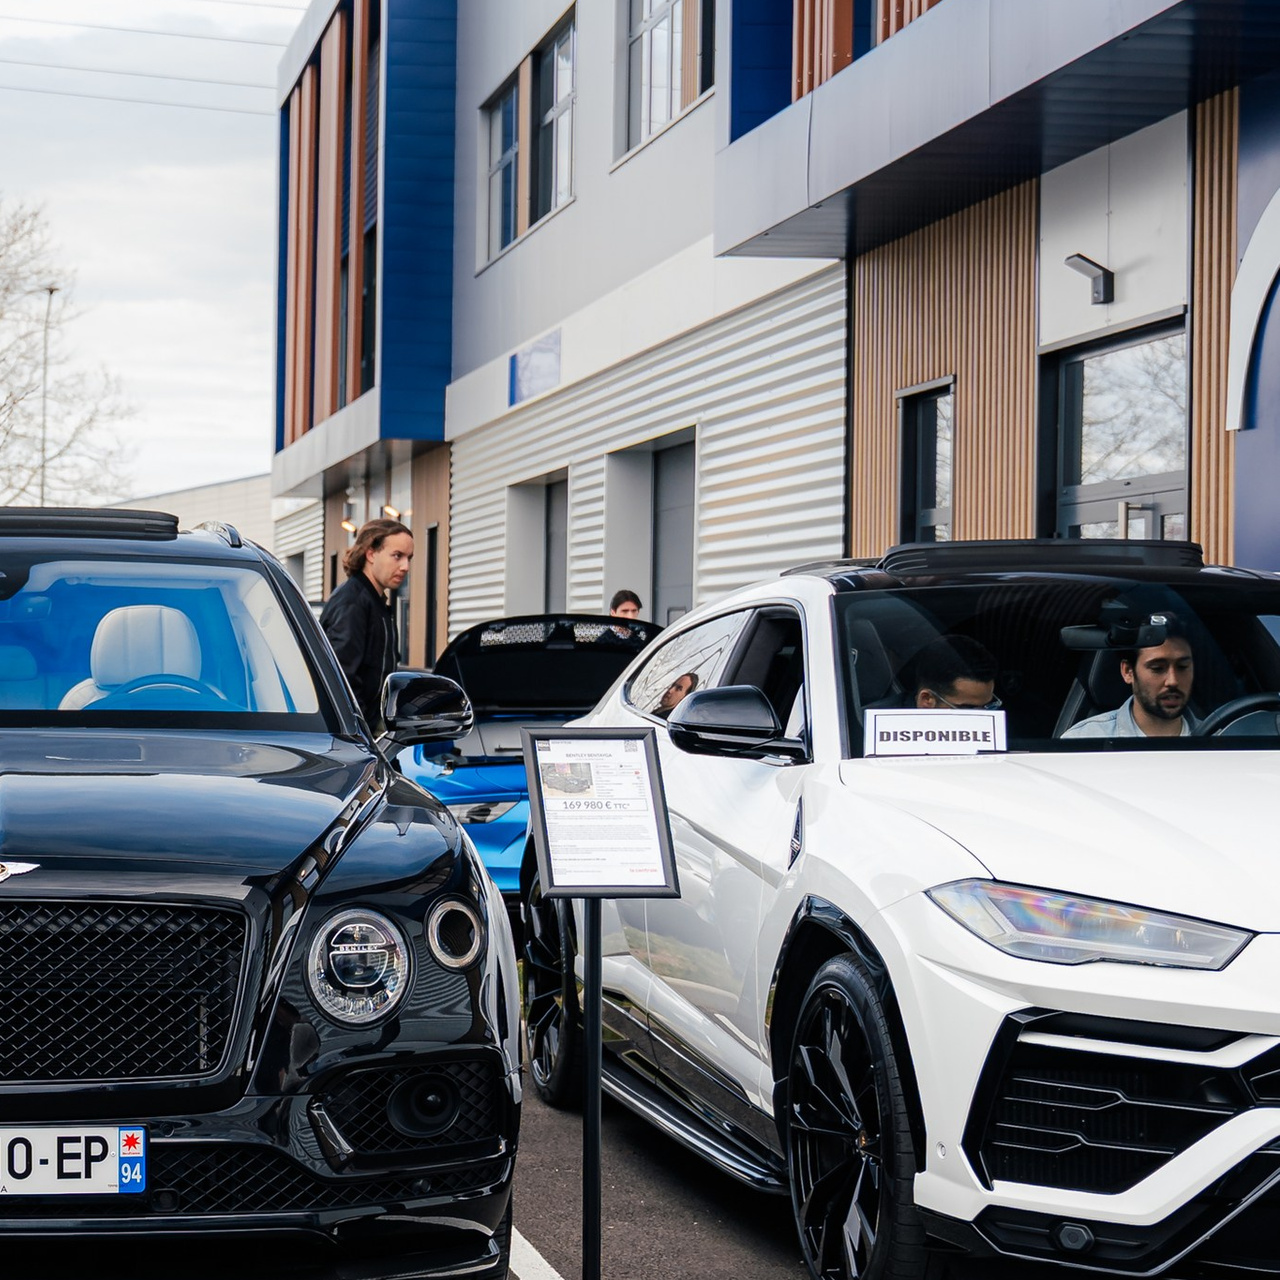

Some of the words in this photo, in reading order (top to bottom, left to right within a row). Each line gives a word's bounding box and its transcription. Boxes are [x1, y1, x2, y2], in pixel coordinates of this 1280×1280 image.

[879, 730, 991, 743] DISPONIBLE
[563, 800, 581, 810] 169
[583, 800, 604, 810] 980
[605, 800, 613, 810] €
[121, 1162, 143, 1184] 94
